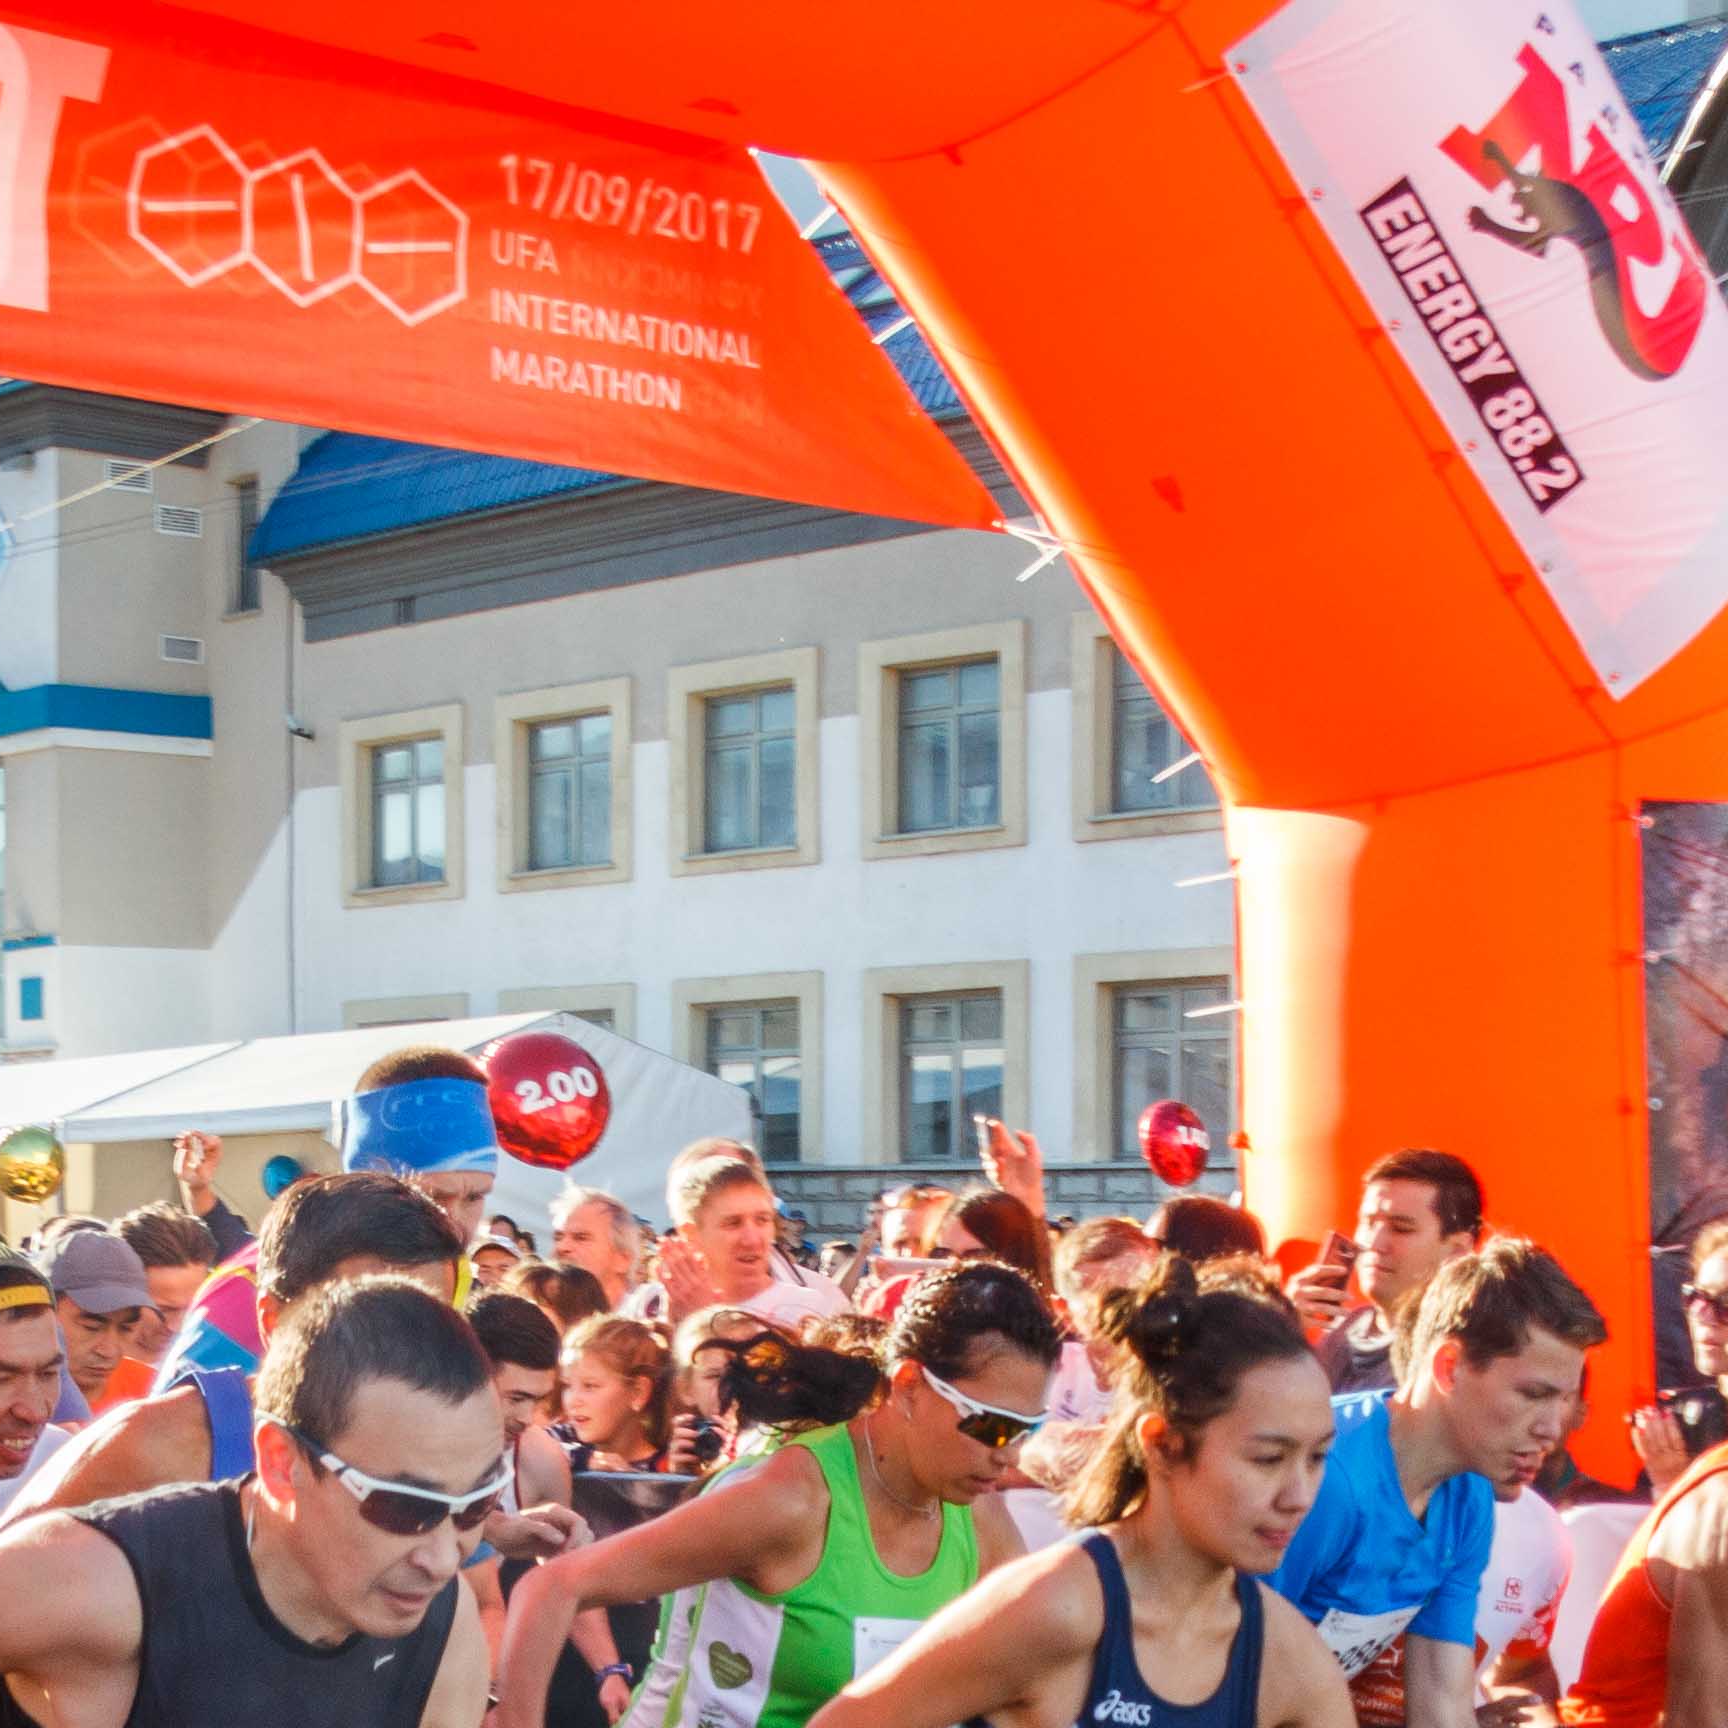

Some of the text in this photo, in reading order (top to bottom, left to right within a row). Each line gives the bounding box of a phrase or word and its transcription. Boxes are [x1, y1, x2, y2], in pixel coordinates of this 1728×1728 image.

[497, 152, 762, 254] 17/09/2017
[490, 229, 560, 275] UFA
[489, 288, 761, 369] INTERNATIONAL
[1371, 191, 1578, 502] ENERGY 88.2
[489, 345, 681, 412] MARATHON
[514, 1066, 599, 1115] 2.00
[1093, 1688, 1152, 1727] asics
